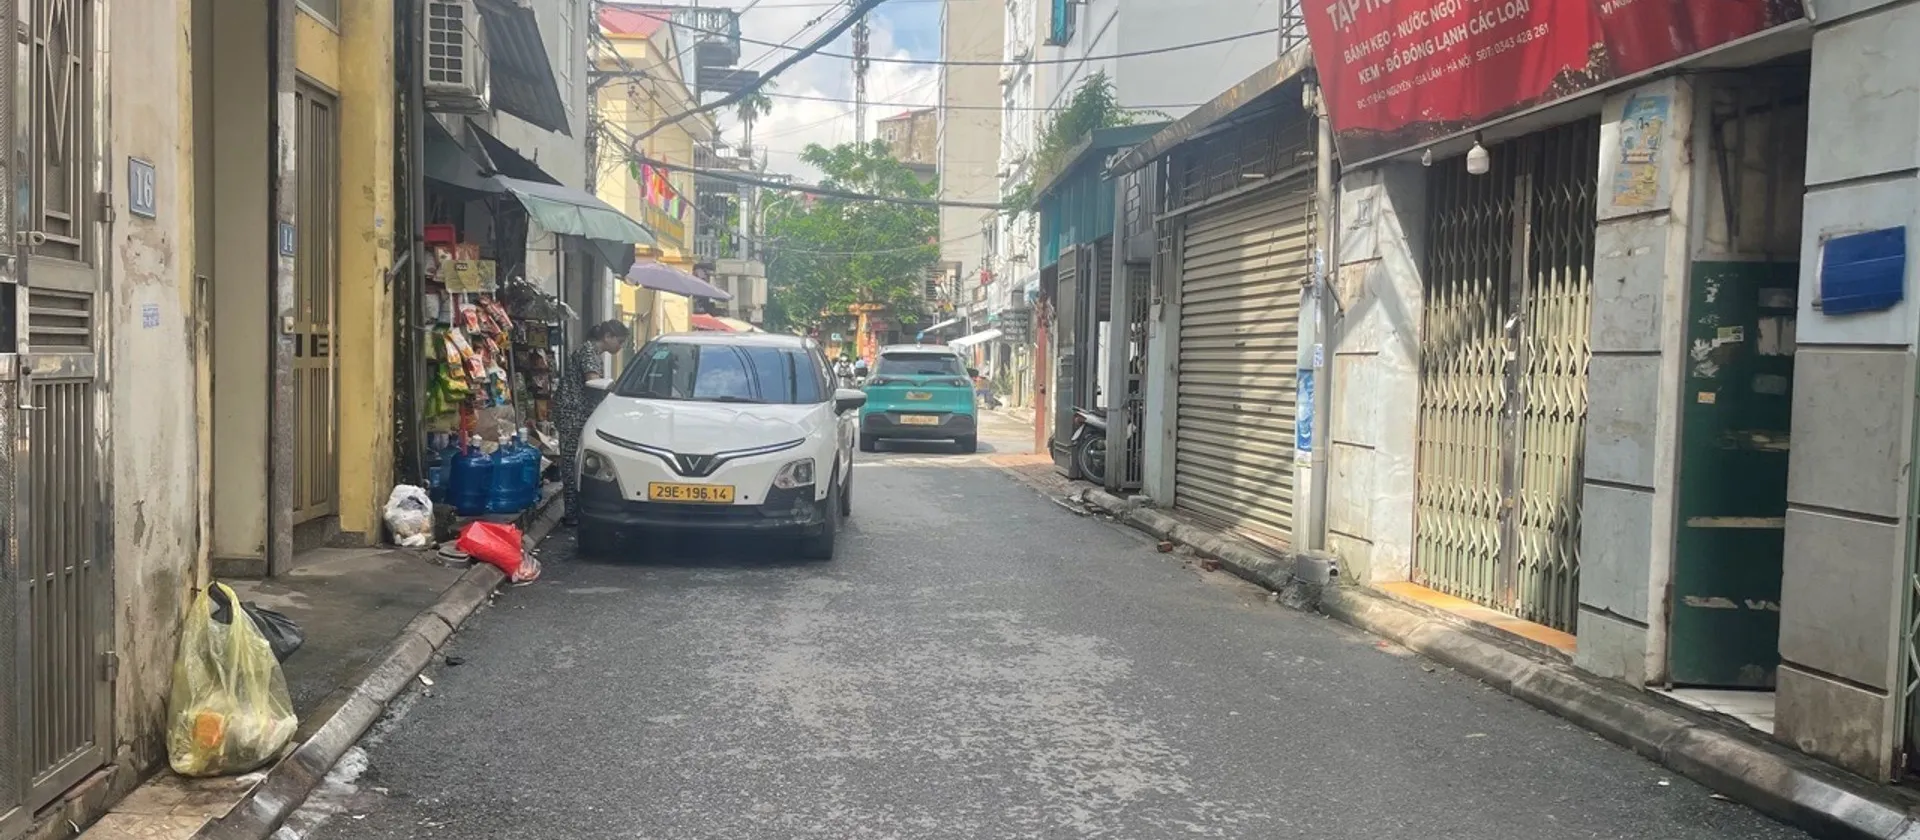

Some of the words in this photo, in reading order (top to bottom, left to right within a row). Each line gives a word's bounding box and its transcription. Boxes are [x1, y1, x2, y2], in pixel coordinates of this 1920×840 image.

[1326, 0, 1361, 33] TẠP
[1344, 43, 1370, 64] BÁNH
[1369, 30, 1391, 51] KẸO
[1397, 10, 1429, 38] NƯỚC
[1430, 0, 1462, 22] NGỌT
[1358, 63, 1380, 85] KEM
[1402, 38, 1434, 65] ĐÔNG
[1434, 22, 1468, 51] LẠNH
[1469, 10, 1496, 35] CÁC
[1497, 0, 1530, 23] LOẠI
[1494, 37, 1515, 54] 0343
[1517, 30, 1533, 43] 428
[1533, 22, 1549, 38] 261
[135, 167, 153, 208] 16
[283, 229, 293, 252] 14
